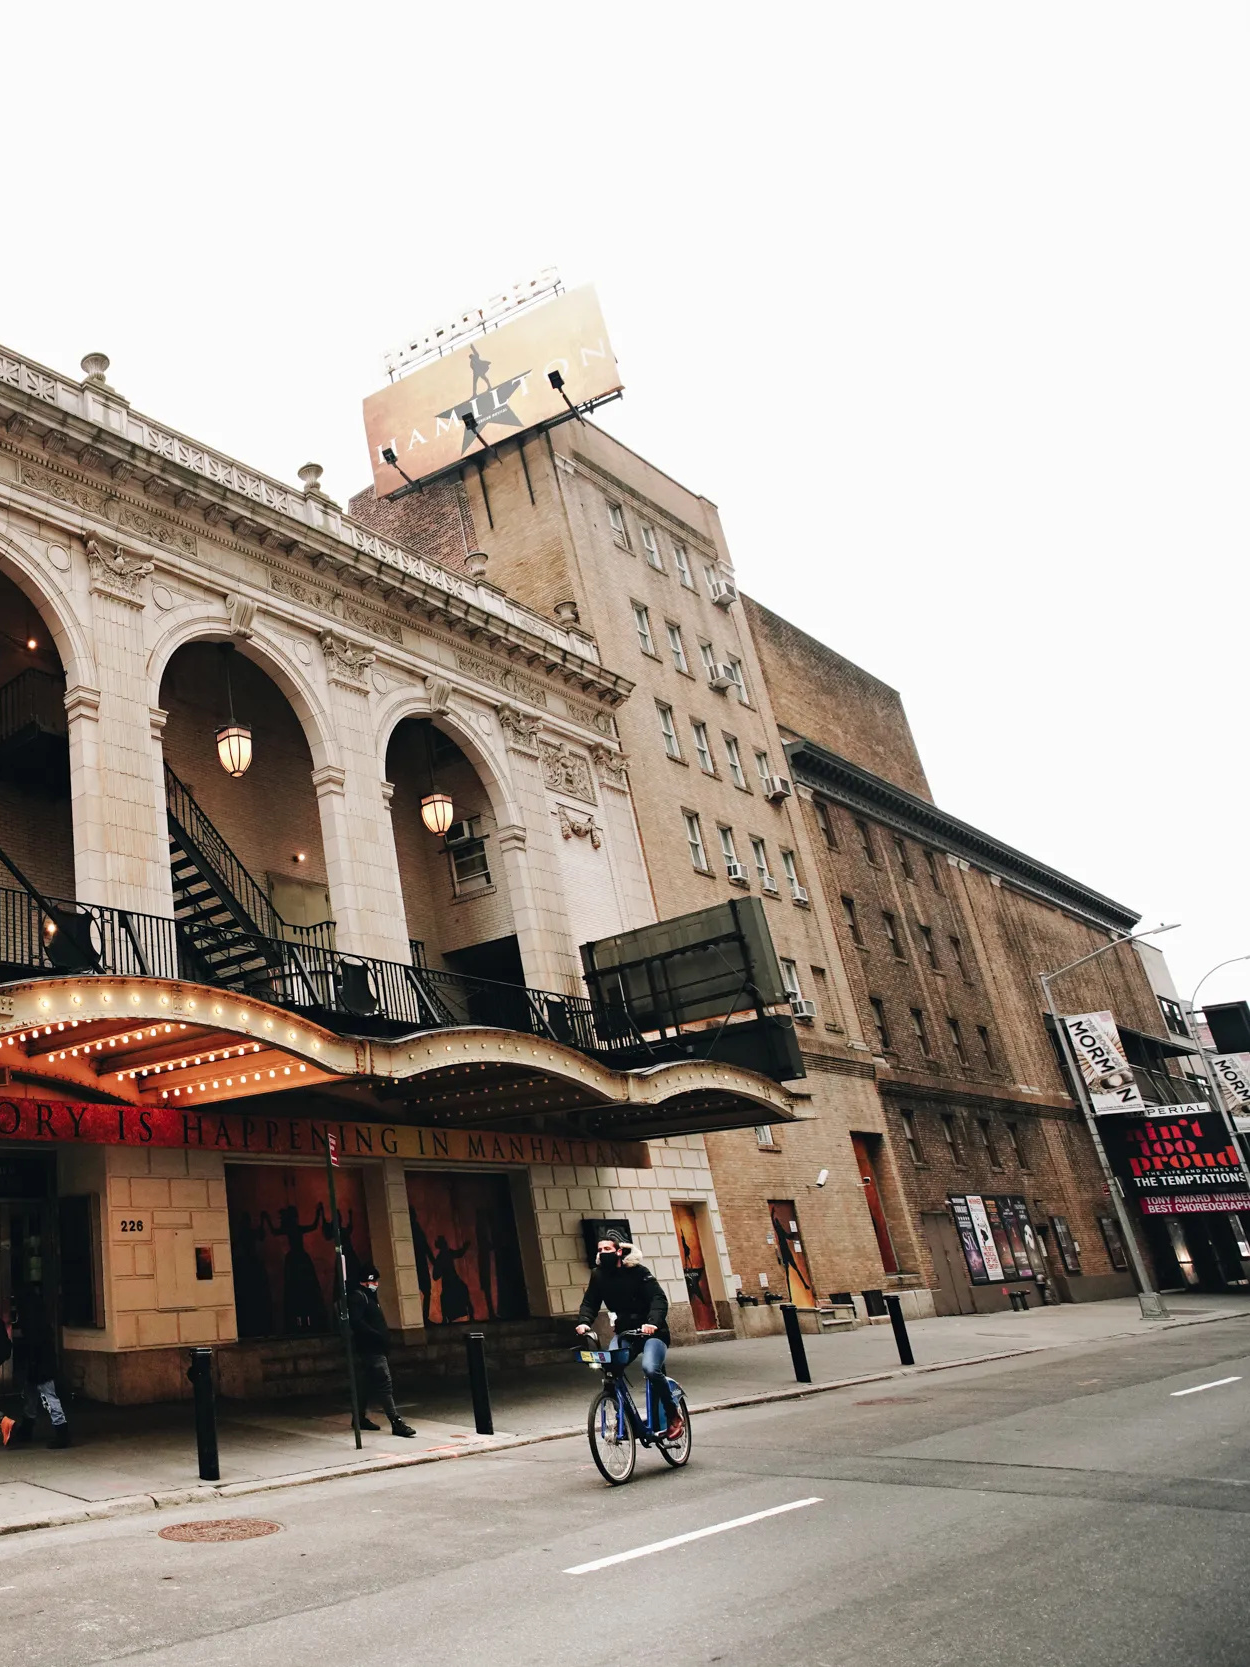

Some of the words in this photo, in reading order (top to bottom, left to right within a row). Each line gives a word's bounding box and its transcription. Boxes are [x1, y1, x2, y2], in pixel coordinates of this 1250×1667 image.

[376, 340, 608, 465] HAMILTON
[118, 1109, 154, 1143] IS
[182, 1115, 399, 1155] HAPPENING
[418, 1129, 451, 1156] IN
[467, 1132, 624, 1166] MANHATTAN
[1130, 1145, 1240, 1177] proud
[1133, 1177, 1159, 1187] THE
[1162, 1172, 1246, 1186] TEMPTATIONS
[1145, 1195, 1171, 1205] TONY
[1174, 1193, 1211, 1204] AWARD
[1147, 1204, 1173, 1213] BEST
[120, 1220, 144, 1232] 226
